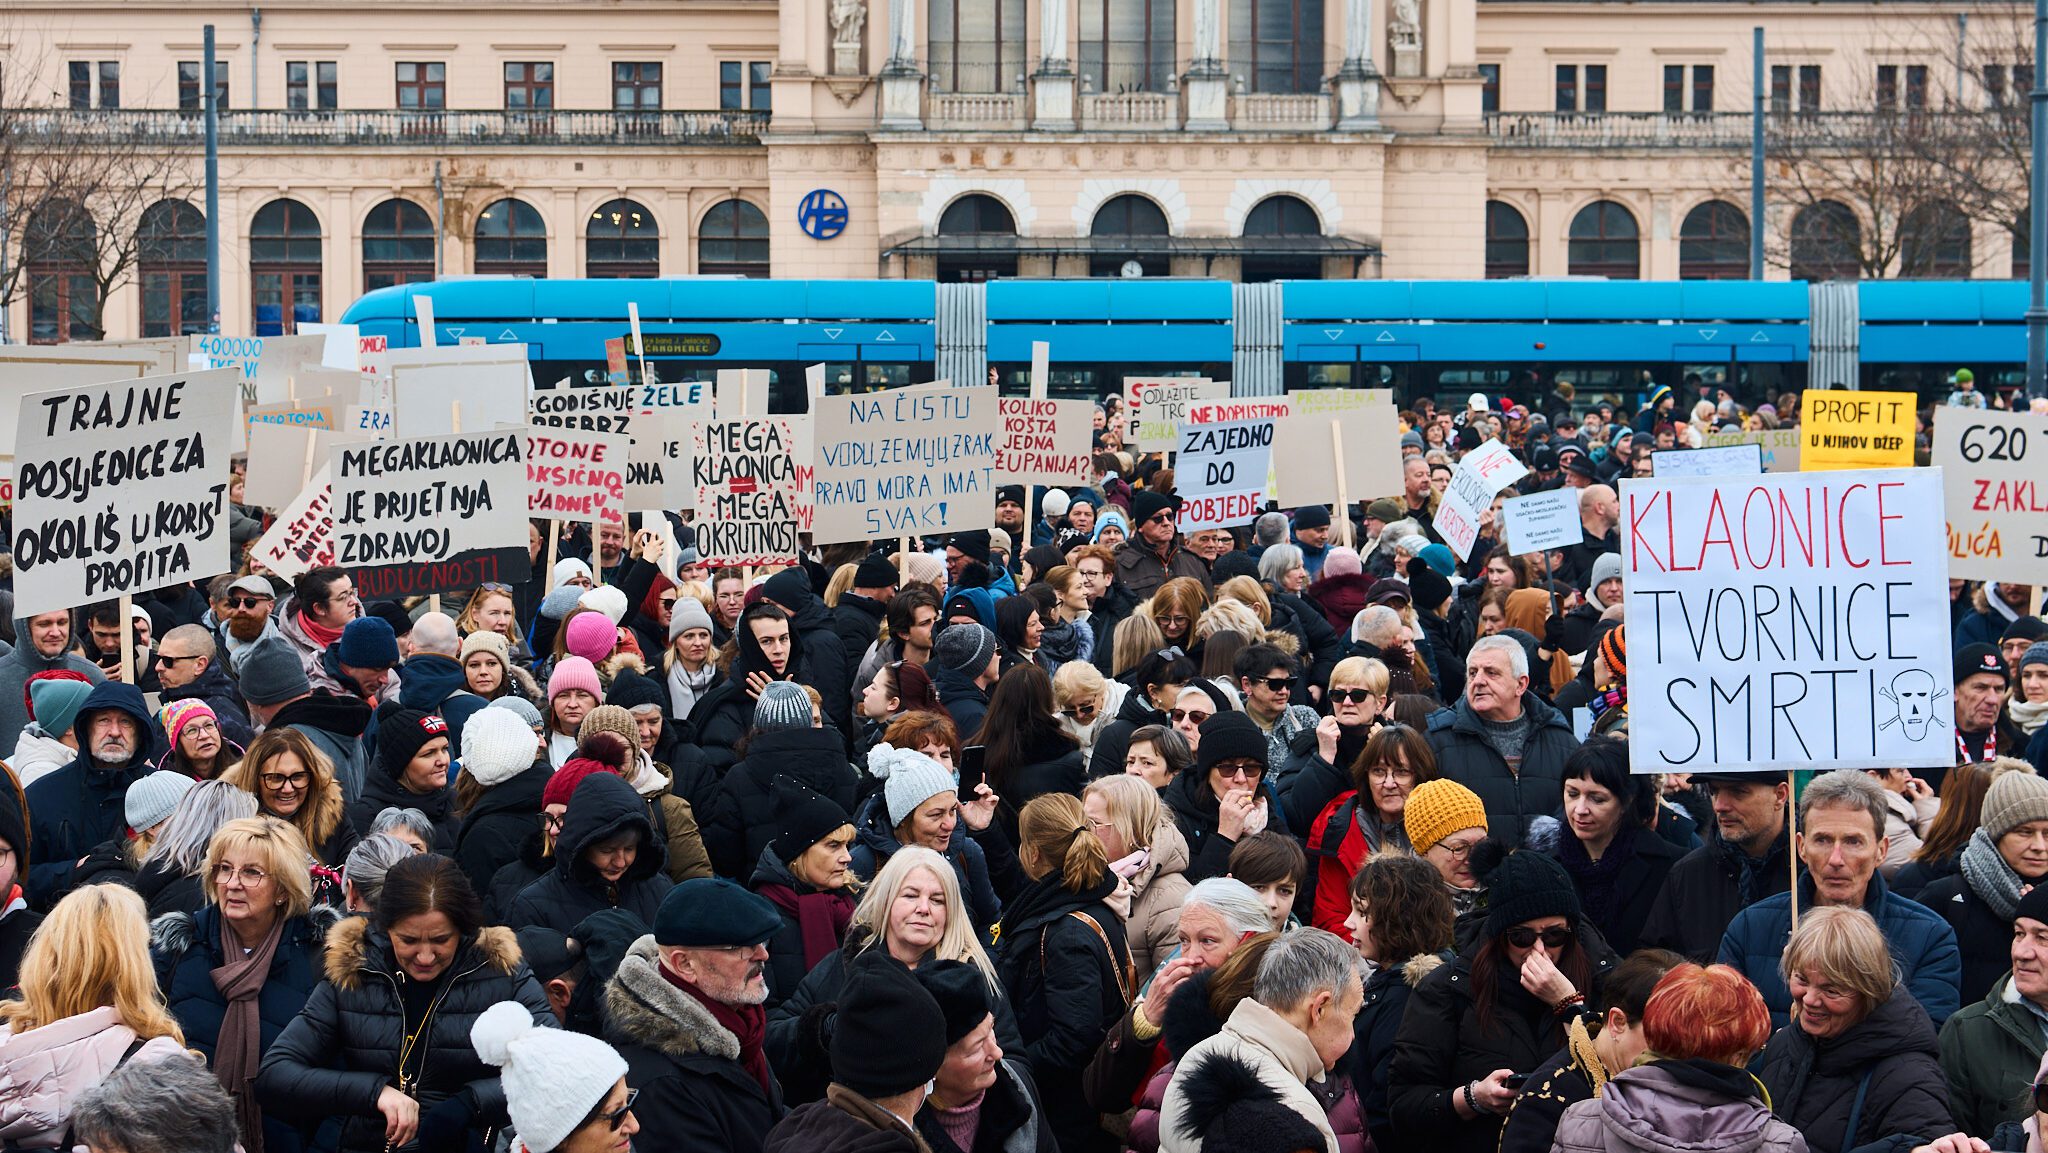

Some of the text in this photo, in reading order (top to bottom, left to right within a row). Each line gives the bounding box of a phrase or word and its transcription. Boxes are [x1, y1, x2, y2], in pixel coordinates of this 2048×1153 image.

[200, 336, 263, 358] 400000
[42, 381, 186, 437] TRAJNE
[529, 388, 635, 413] GODIŠNJE
[850, 392, 970, 424] NA ČISTU
[999, 399, 1057, 416] KOLIKO
[1191, 406, 1213, 424] NE
[1813, 400, 1904, 424] PROFIT
[707, 421, 782, 454] MEGA
[1005, 416, 1056, 434] KOŠTA
[1183, 423, 1274, 455] ZAJEDNO
[1774, 431, 1801, 448] SEL
[341, 434, 520, 477] MEGAKLAONICA
[1003, 434, 1055, 451] JEDNA
[1811, 434, 1904, 450] U NJIHOV DŽEP
[1960, 424, 2027, 463] 620
[18, 439, 169, 503] POSLJEDICE
[170, 432, 205, 472] ZA
[693, 454, 796, 488] KLAONICA
[995, 449, 1090, 481] ŽUPANIJA?
[1206, 461, 1235, 486] DO
[1473, 449, 1512, 478] NE
[339, 479, 492, 524] JE PRIJETNJA
[816, 478, 867, 505] PRAVO
[877, 473, 932, 502] MORA
[1972, 480, 2048, 512] ZAKL
[717, 490, 789, 521] MEGA
[866, 502, 948, 534] SVAK!
[1177, 492, 1261, 525] POBJEDE
[14, 483, 227, 572] OKOLIŠ U KORIST
[696, 521, 799, 558] OKRUTNOST
[1630, 482, 1913, 573] KLAONICE
[340, 528, 450, 562] ZDRAVOJ
[85, 543, 190, 596] PROFITA
[357, 555, 499, 598] BUDUĆNOSTI
[1633, 582, 1919, 664] TVORNICE
[1659, 668, 1877, 765] SMRTI
